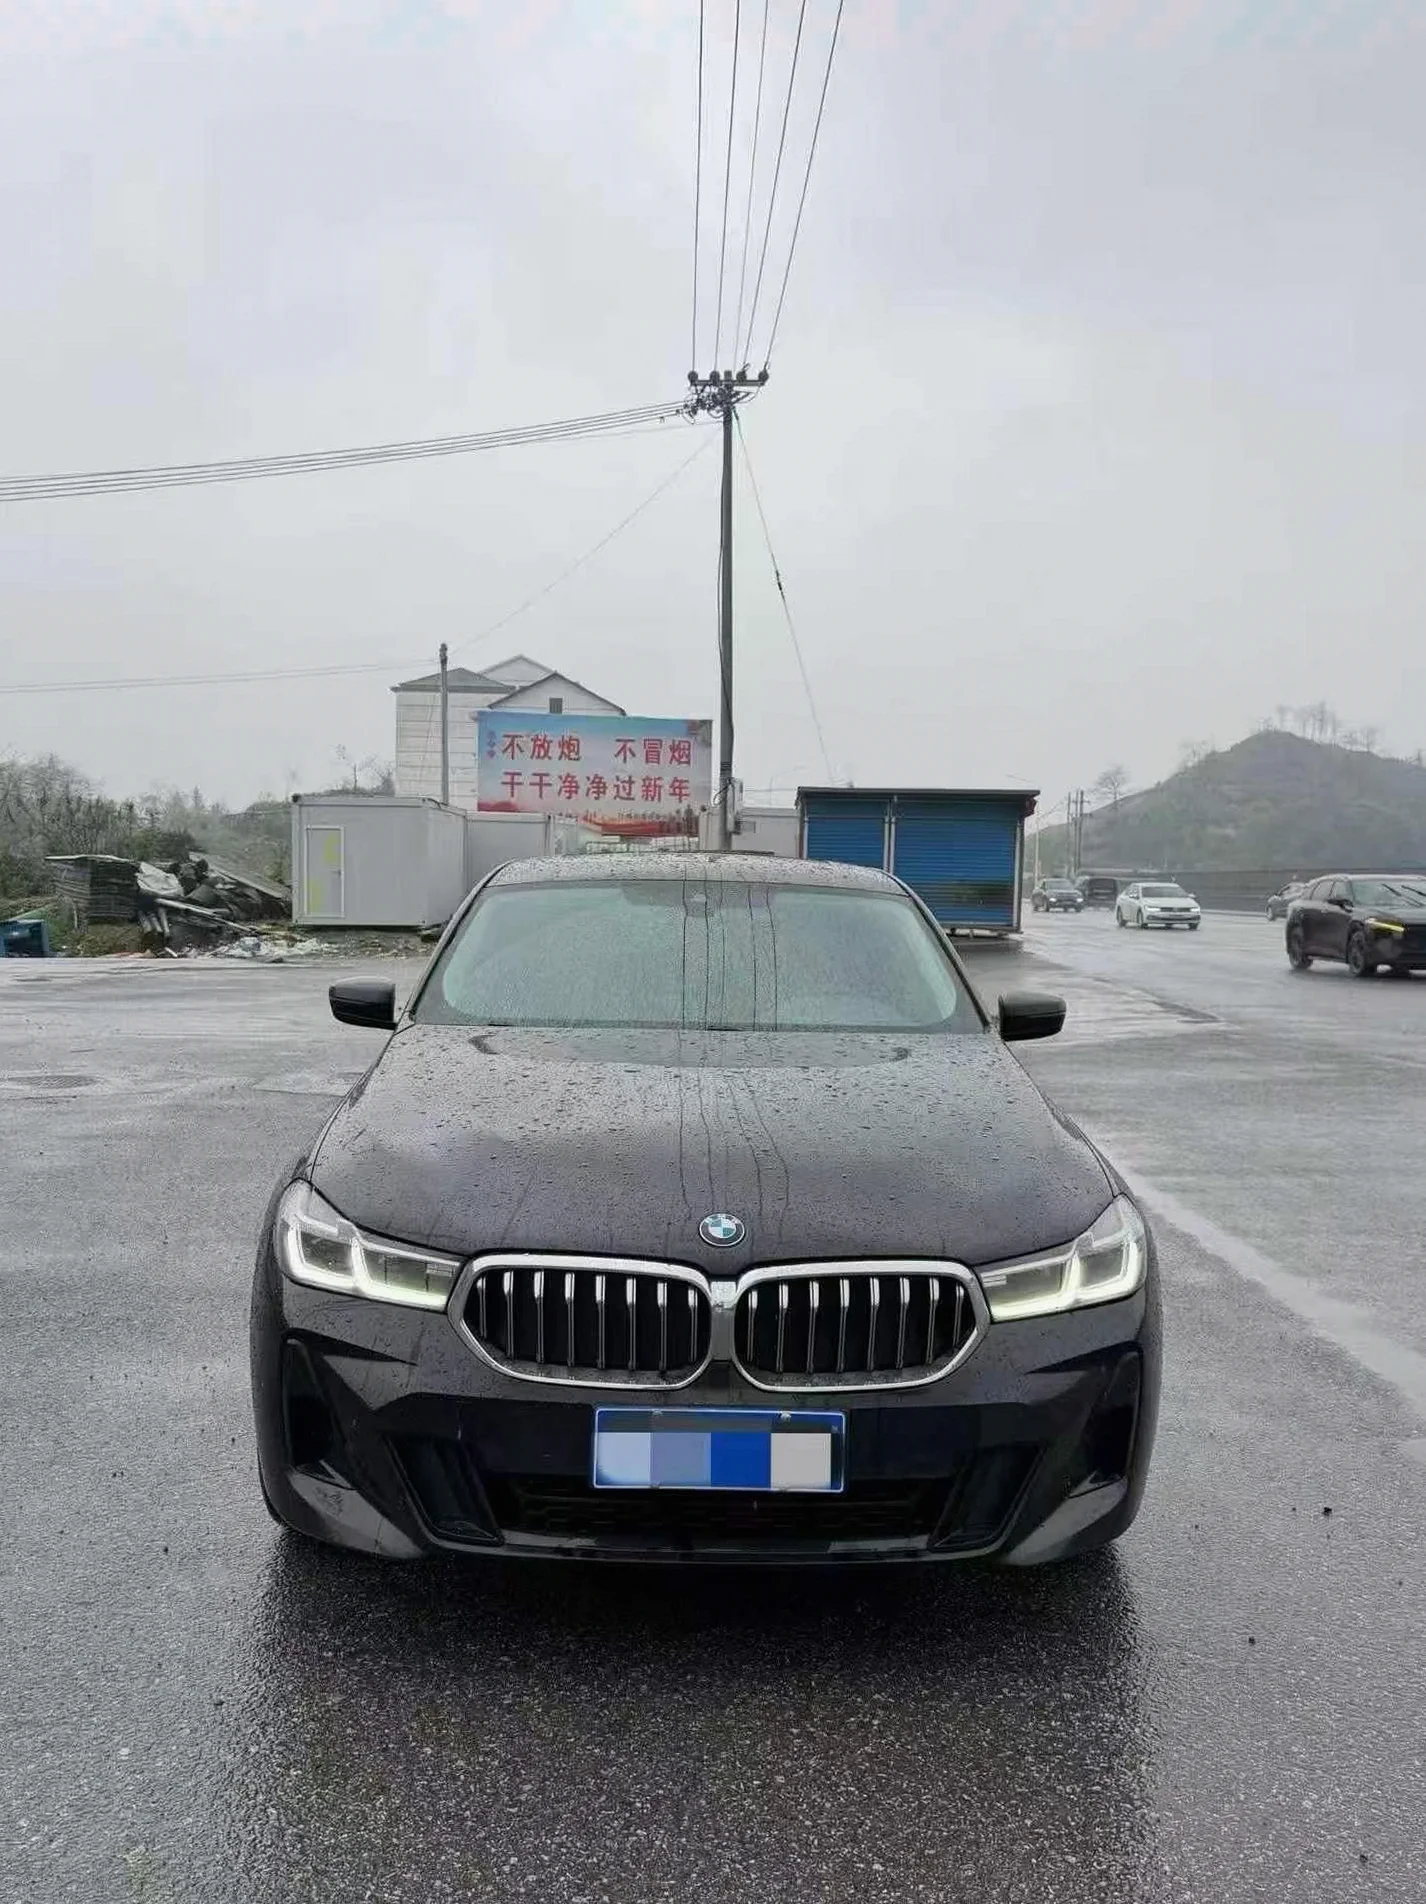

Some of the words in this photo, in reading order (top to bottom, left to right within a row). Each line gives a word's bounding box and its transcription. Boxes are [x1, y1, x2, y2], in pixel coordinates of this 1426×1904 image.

[502, 733, 582, 762] 不放炮
[614, 738, 692, 766] 不冒烟
[501, 771, 692, 803] 干干净净过新年
